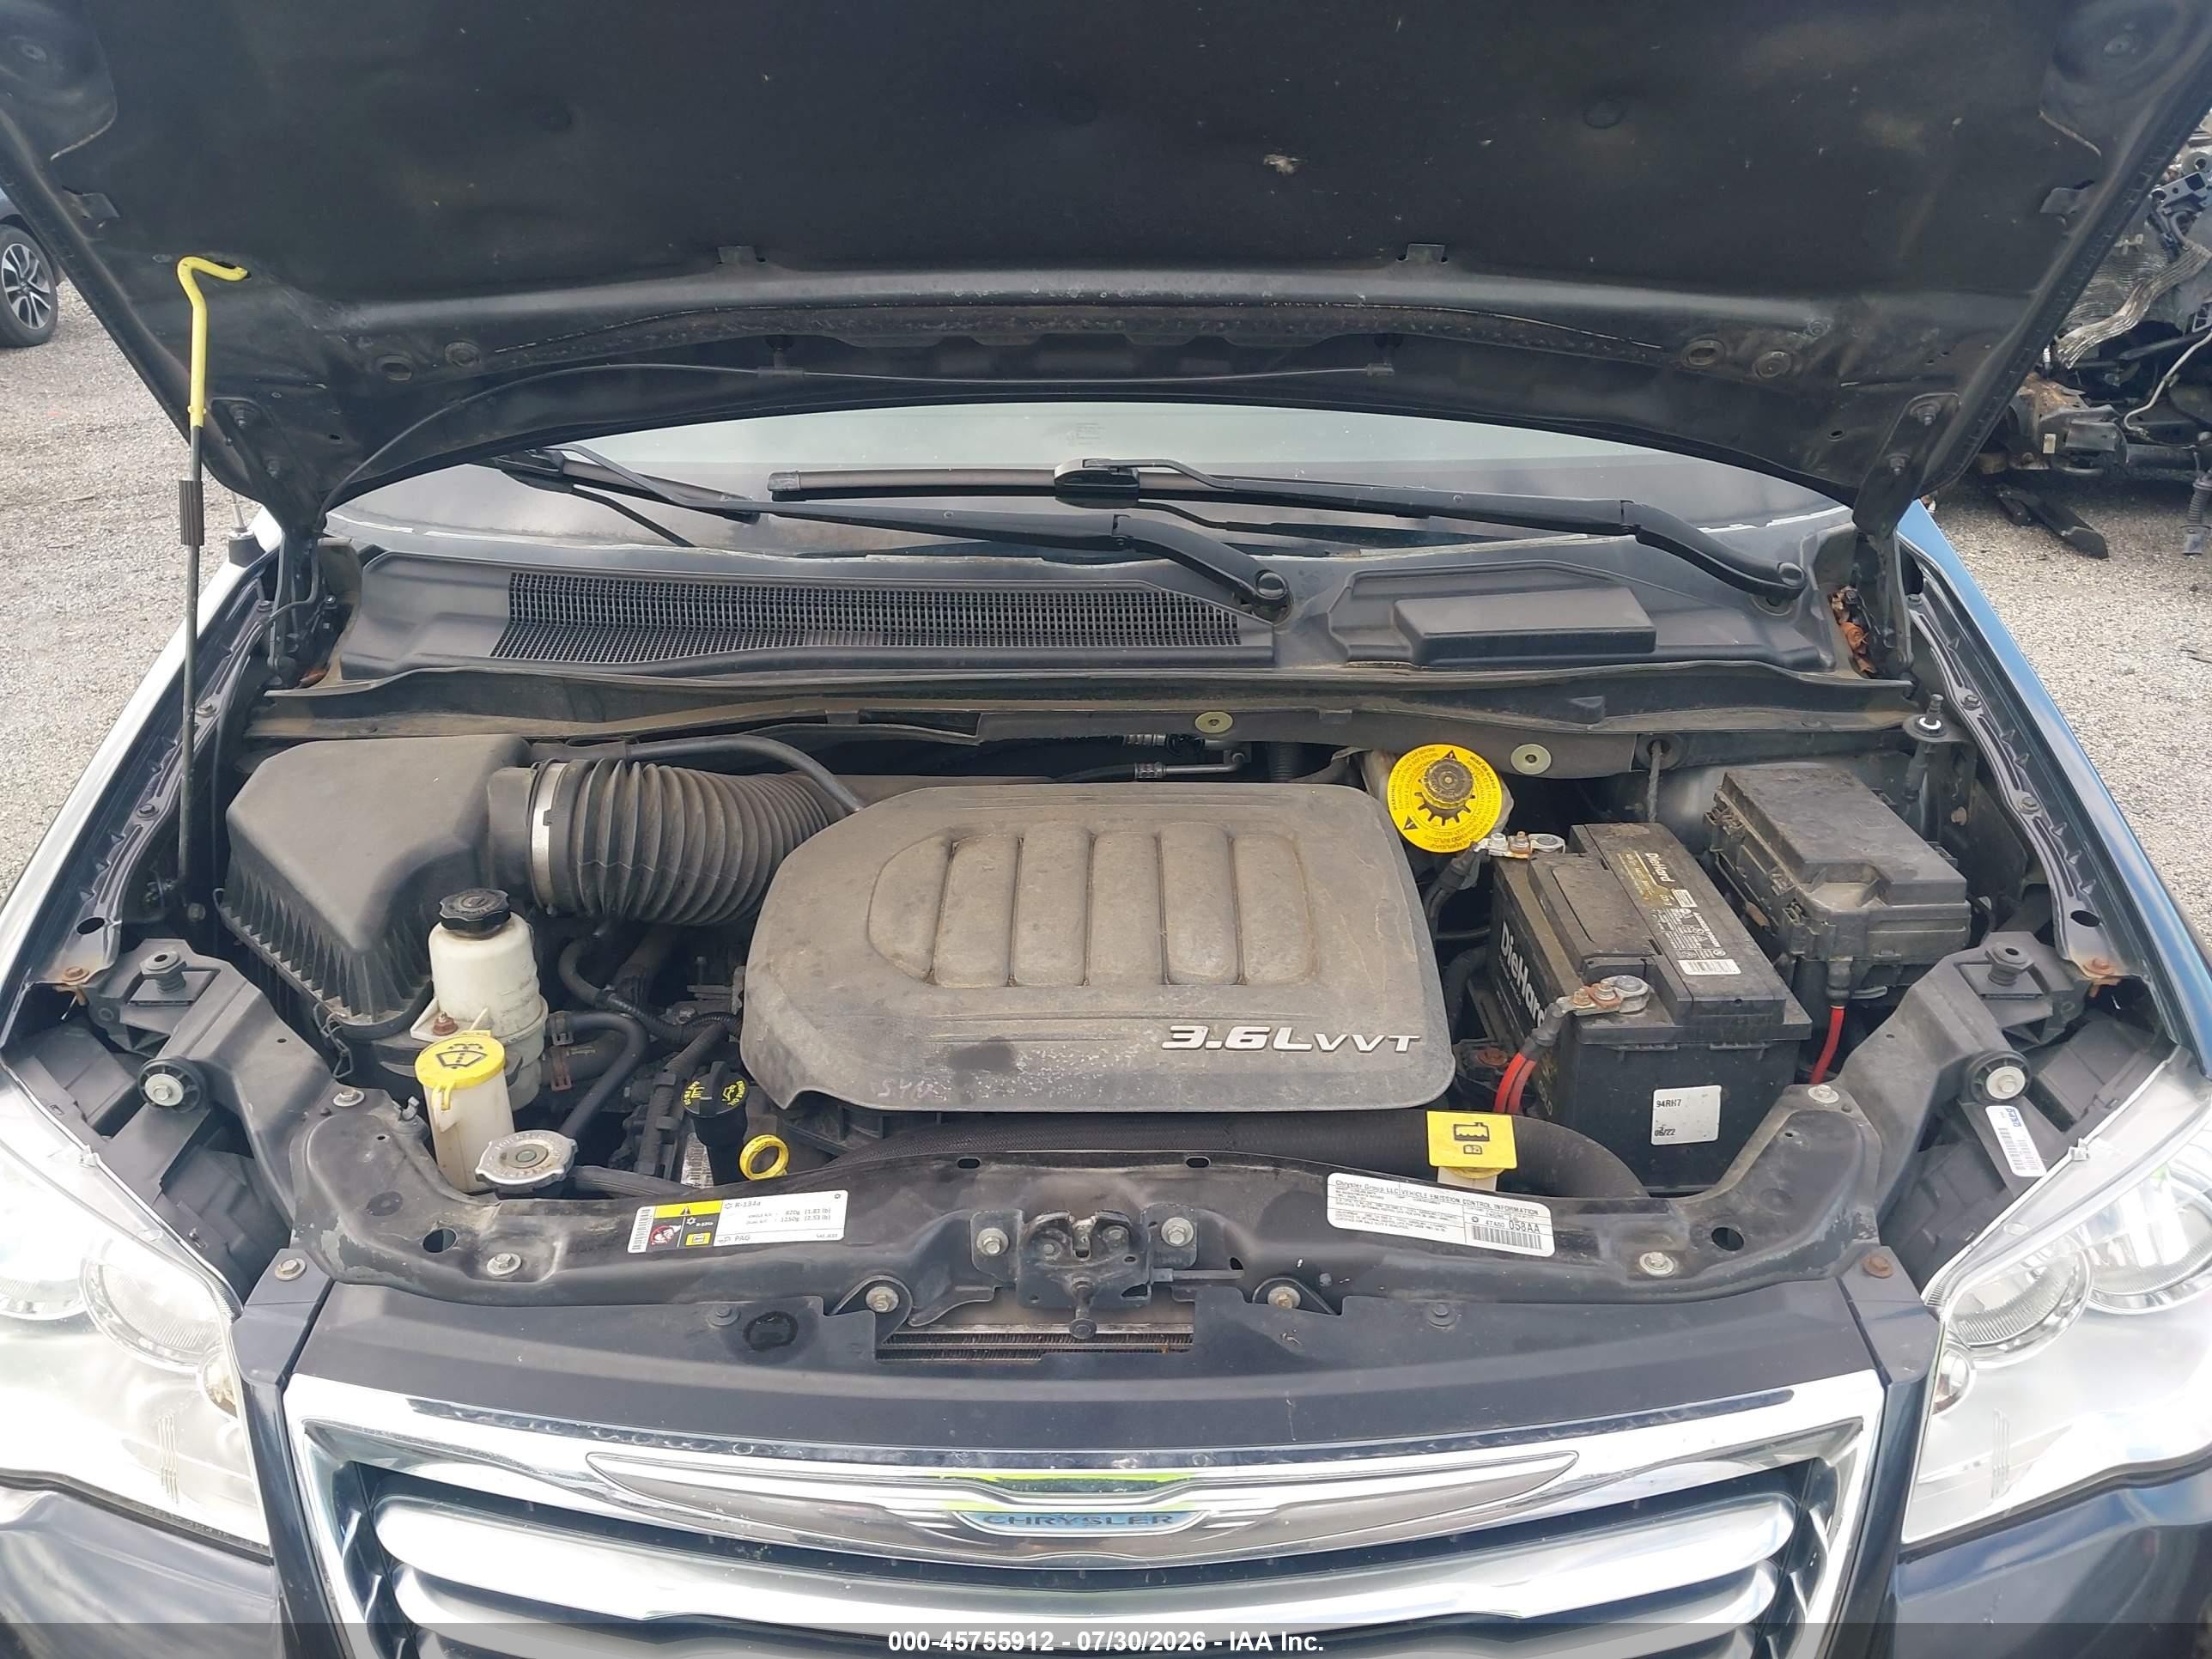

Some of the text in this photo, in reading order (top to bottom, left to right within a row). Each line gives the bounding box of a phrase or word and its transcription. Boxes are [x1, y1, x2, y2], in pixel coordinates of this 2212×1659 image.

[1644, 853, 1675, 883] DieHard
[1335, 1180, 1362, 1189] Chrysler
[1364, 1184, 1384, 1194] Group
[1401, 1189, 1427, 1198] VEHICLE
[1430, 1194, 1460, 1203] EMISSION
[1462, 1200, 1492, 1209] CONTROL
[1494, 1204, 1539, 1216] INFORMATION
[1508, 1219, 1540, 1233] 058AA
[983, 1515, 1174, 1526] CHRYSLER
